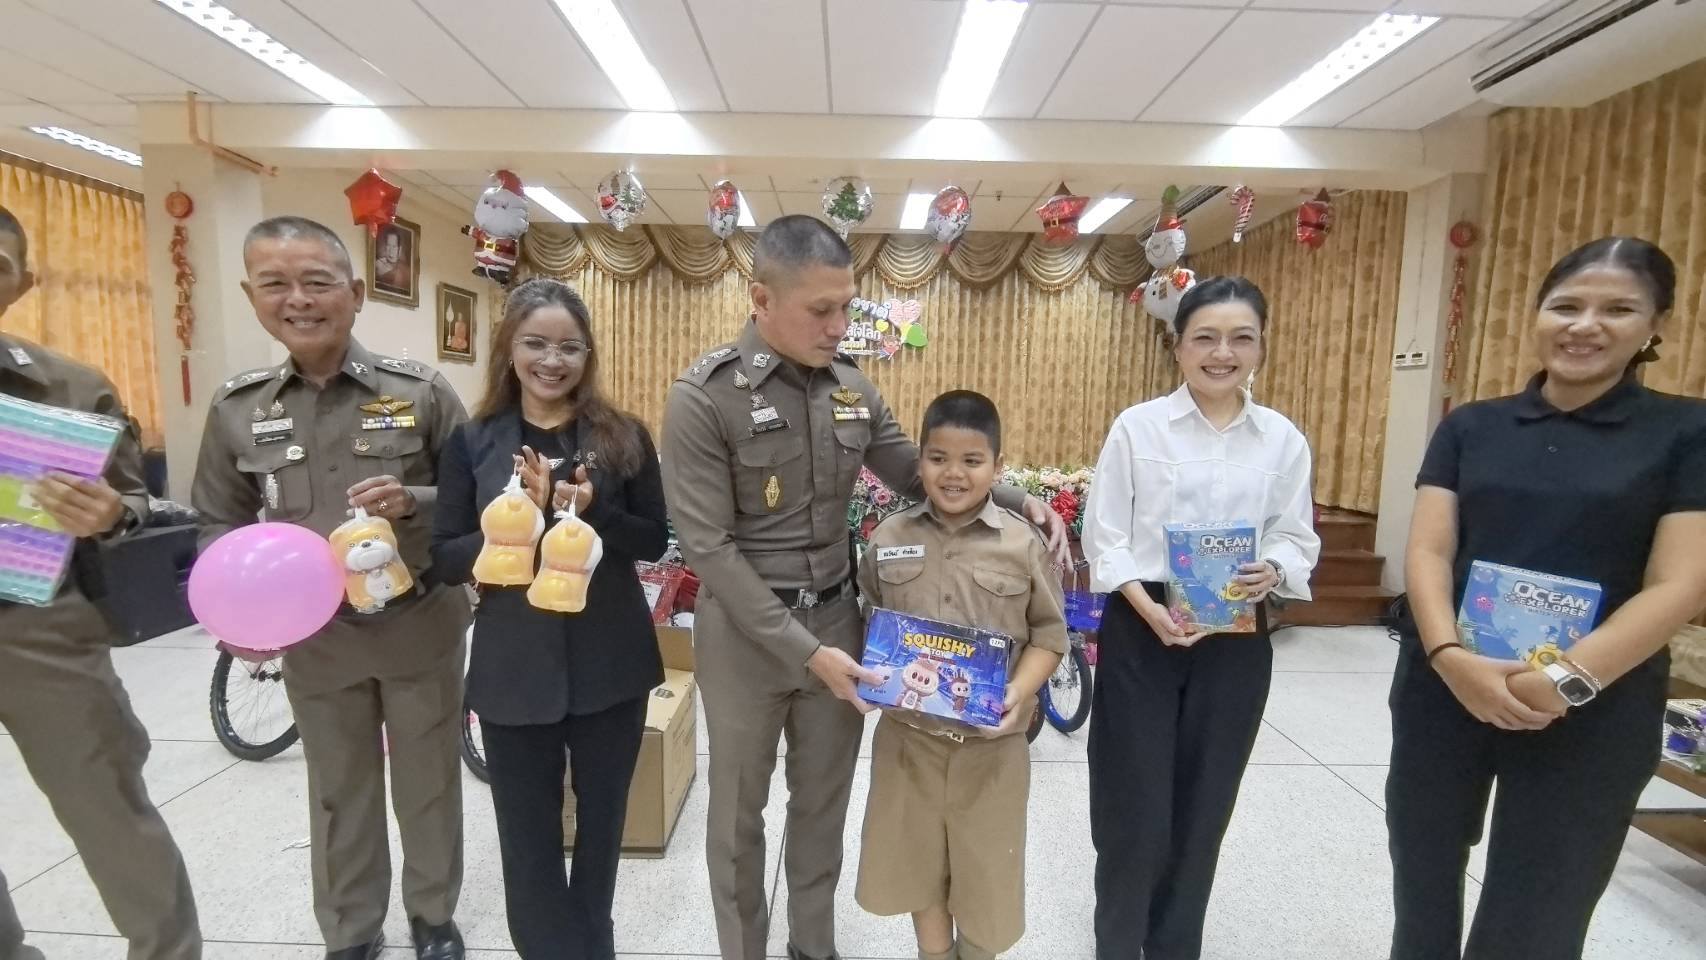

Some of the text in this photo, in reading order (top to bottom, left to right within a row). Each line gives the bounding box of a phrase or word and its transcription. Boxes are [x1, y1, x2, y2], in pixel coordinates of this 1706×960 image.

[1200, 534, 1252, 548] OCEAN
[1207, 546, 1251, 554] EXPLORER
[1513, 580, 1592, 611] OCEAN
[1519, 597, 1586, 617] EXPLORER
[904, 632, 977, 658] SQUISHY
